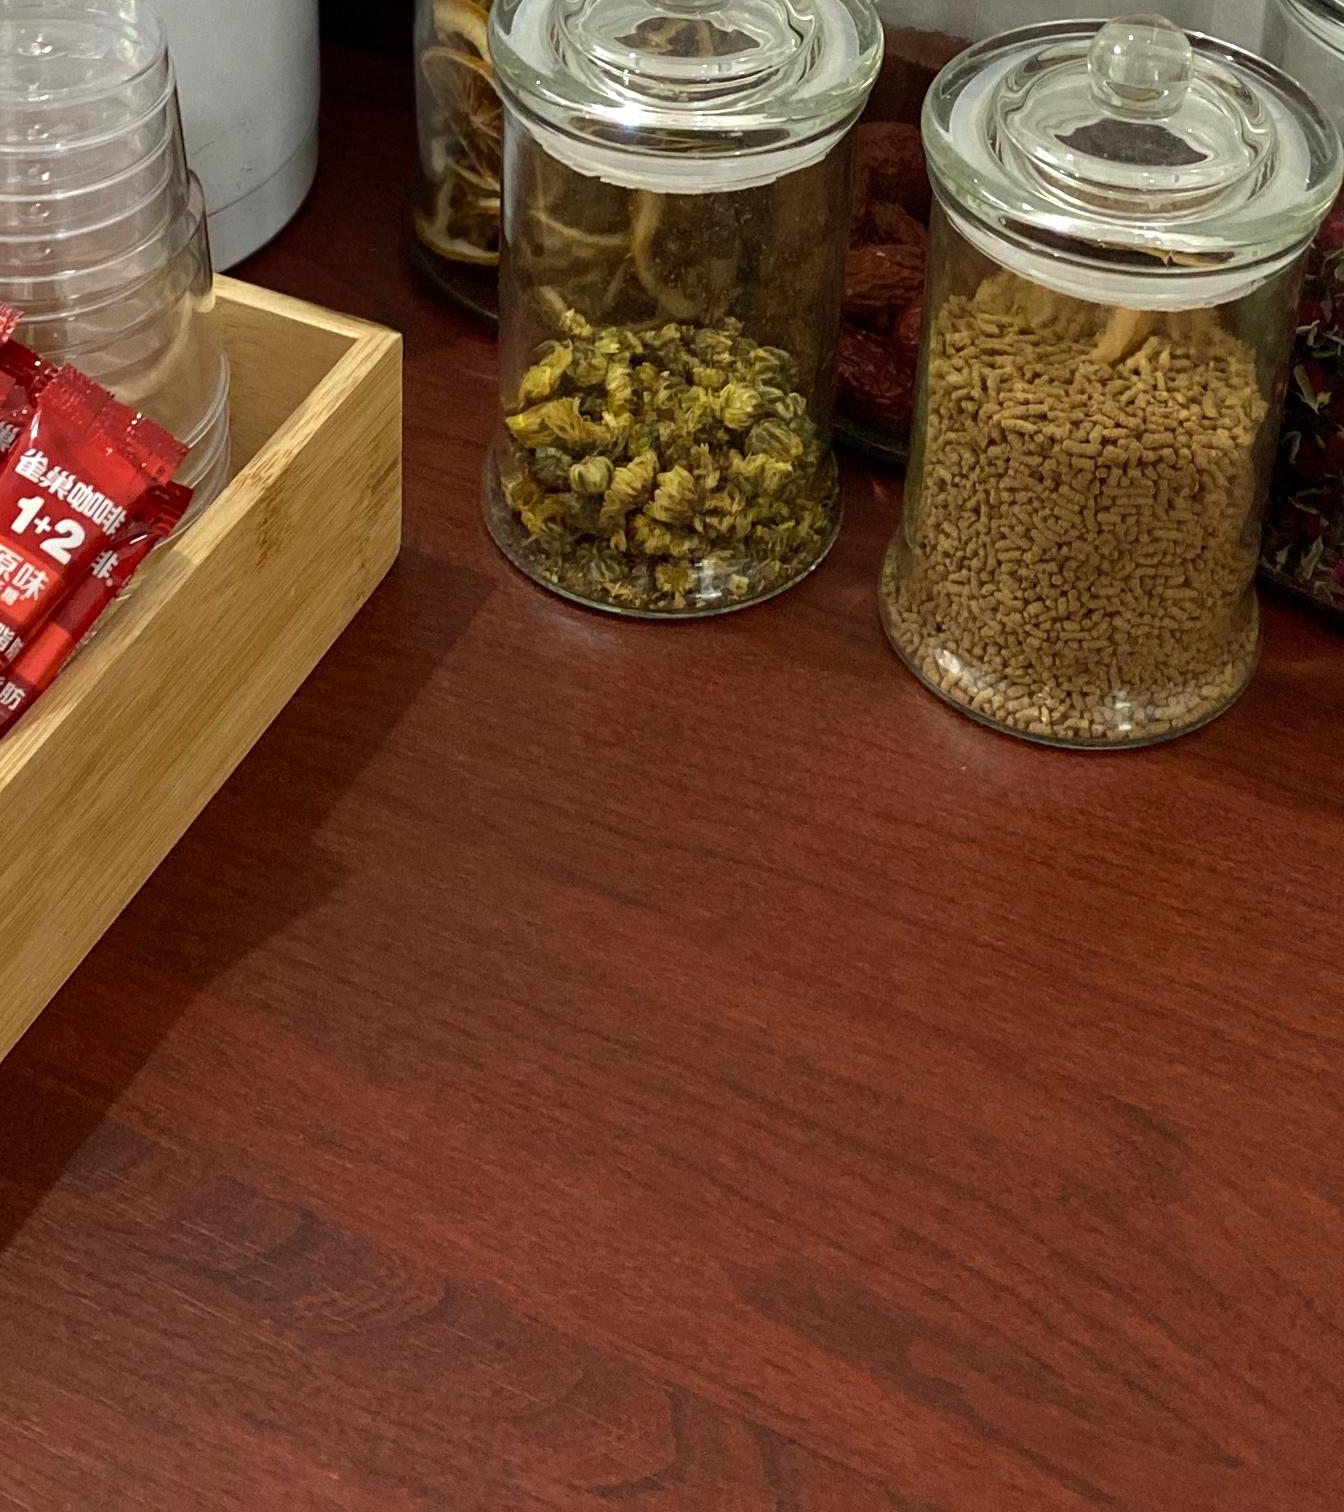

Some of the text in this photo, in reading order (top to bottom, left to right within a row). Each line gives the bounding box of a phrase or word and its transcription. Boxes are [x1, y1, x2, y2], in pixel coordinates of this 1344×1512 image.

[10, 496, 86, 566] 1+2
[15, 448, 127, 537] 雀巢咖啡
